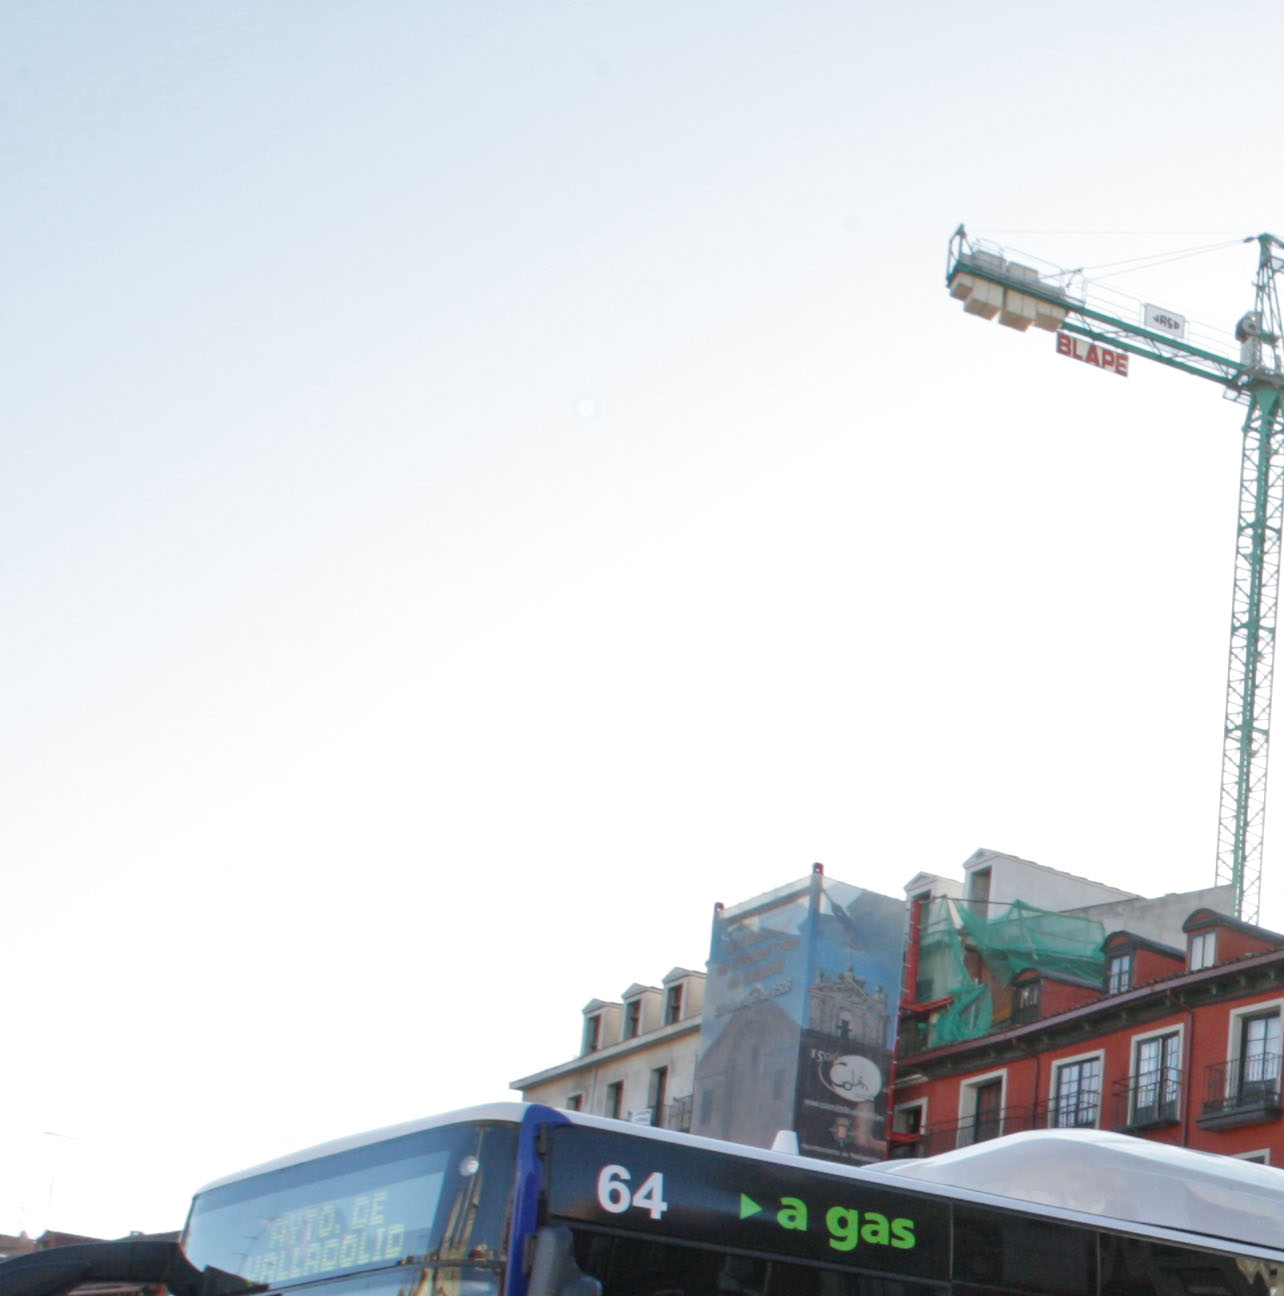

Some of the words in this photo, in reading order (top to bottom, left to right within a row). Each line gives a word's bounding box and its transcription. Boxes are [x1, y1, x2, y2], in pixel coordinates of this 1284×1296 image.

[1059, 334, 1129, 377] BLAPE
[597, 1164, 668, 1221] 64
[776, 1196, 808, 1232] a
[825, 1205, 917, 1251] gas
